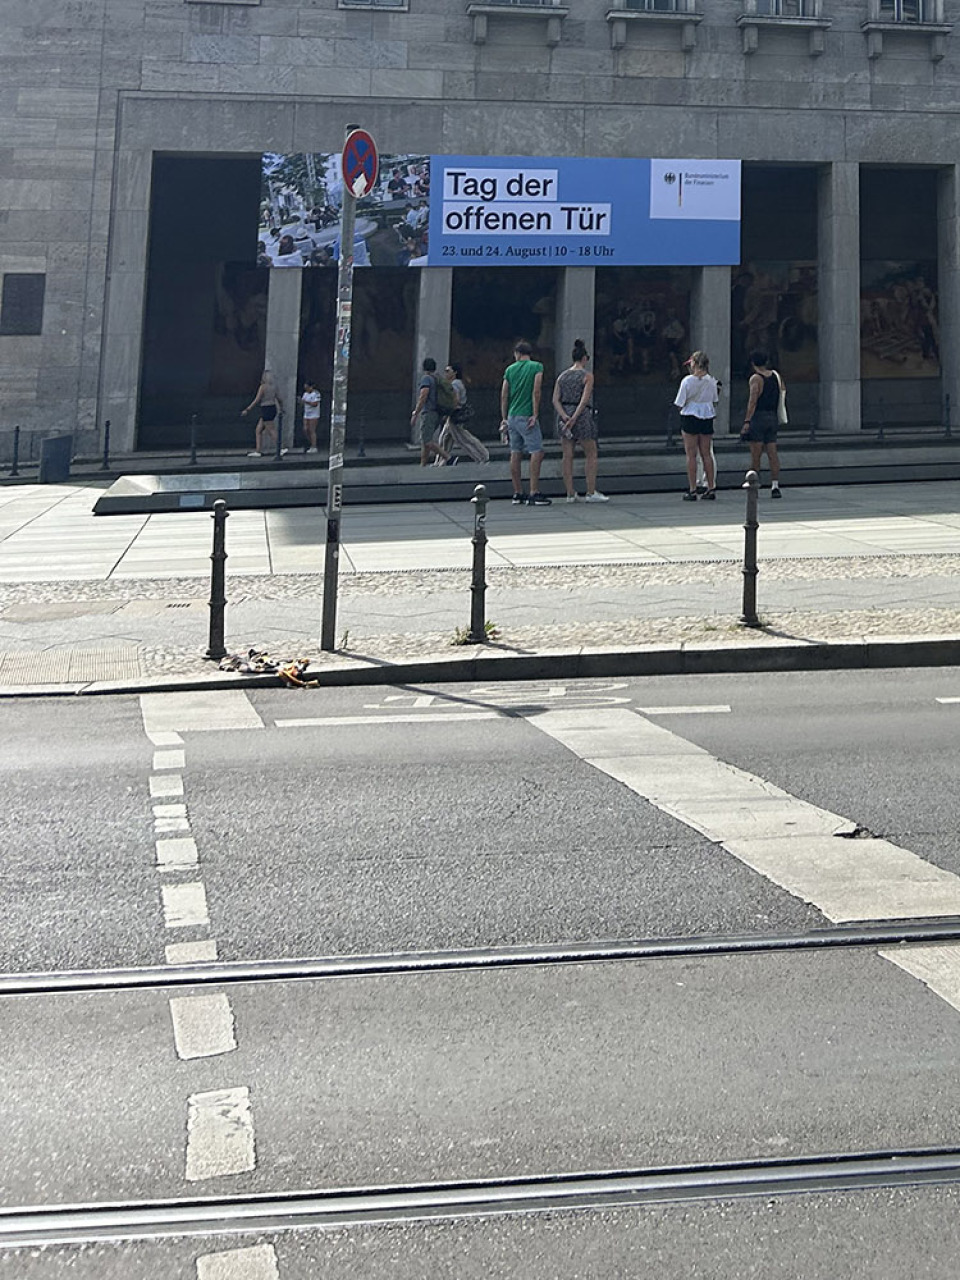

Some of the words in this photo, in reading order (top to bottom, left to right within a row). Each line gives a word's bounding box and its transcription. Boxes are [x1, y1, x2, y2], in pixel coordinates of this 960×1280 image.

[447, 172, 498, 201] Tag
[506, 173, 553, 197] der
[445, 206, 552, 231] offenen
[560, 206, 607, 231] Tür
[442, 245, 458, 256] 23.
[460, 245, 484, 257] und
[485, 245, 503, 257] 24.
[504, 245, 546, 259] August
[555, 246, 568, 257] 10
[578, 246, 591, 257] 18
[592, 246, 615, 257] Uhr
